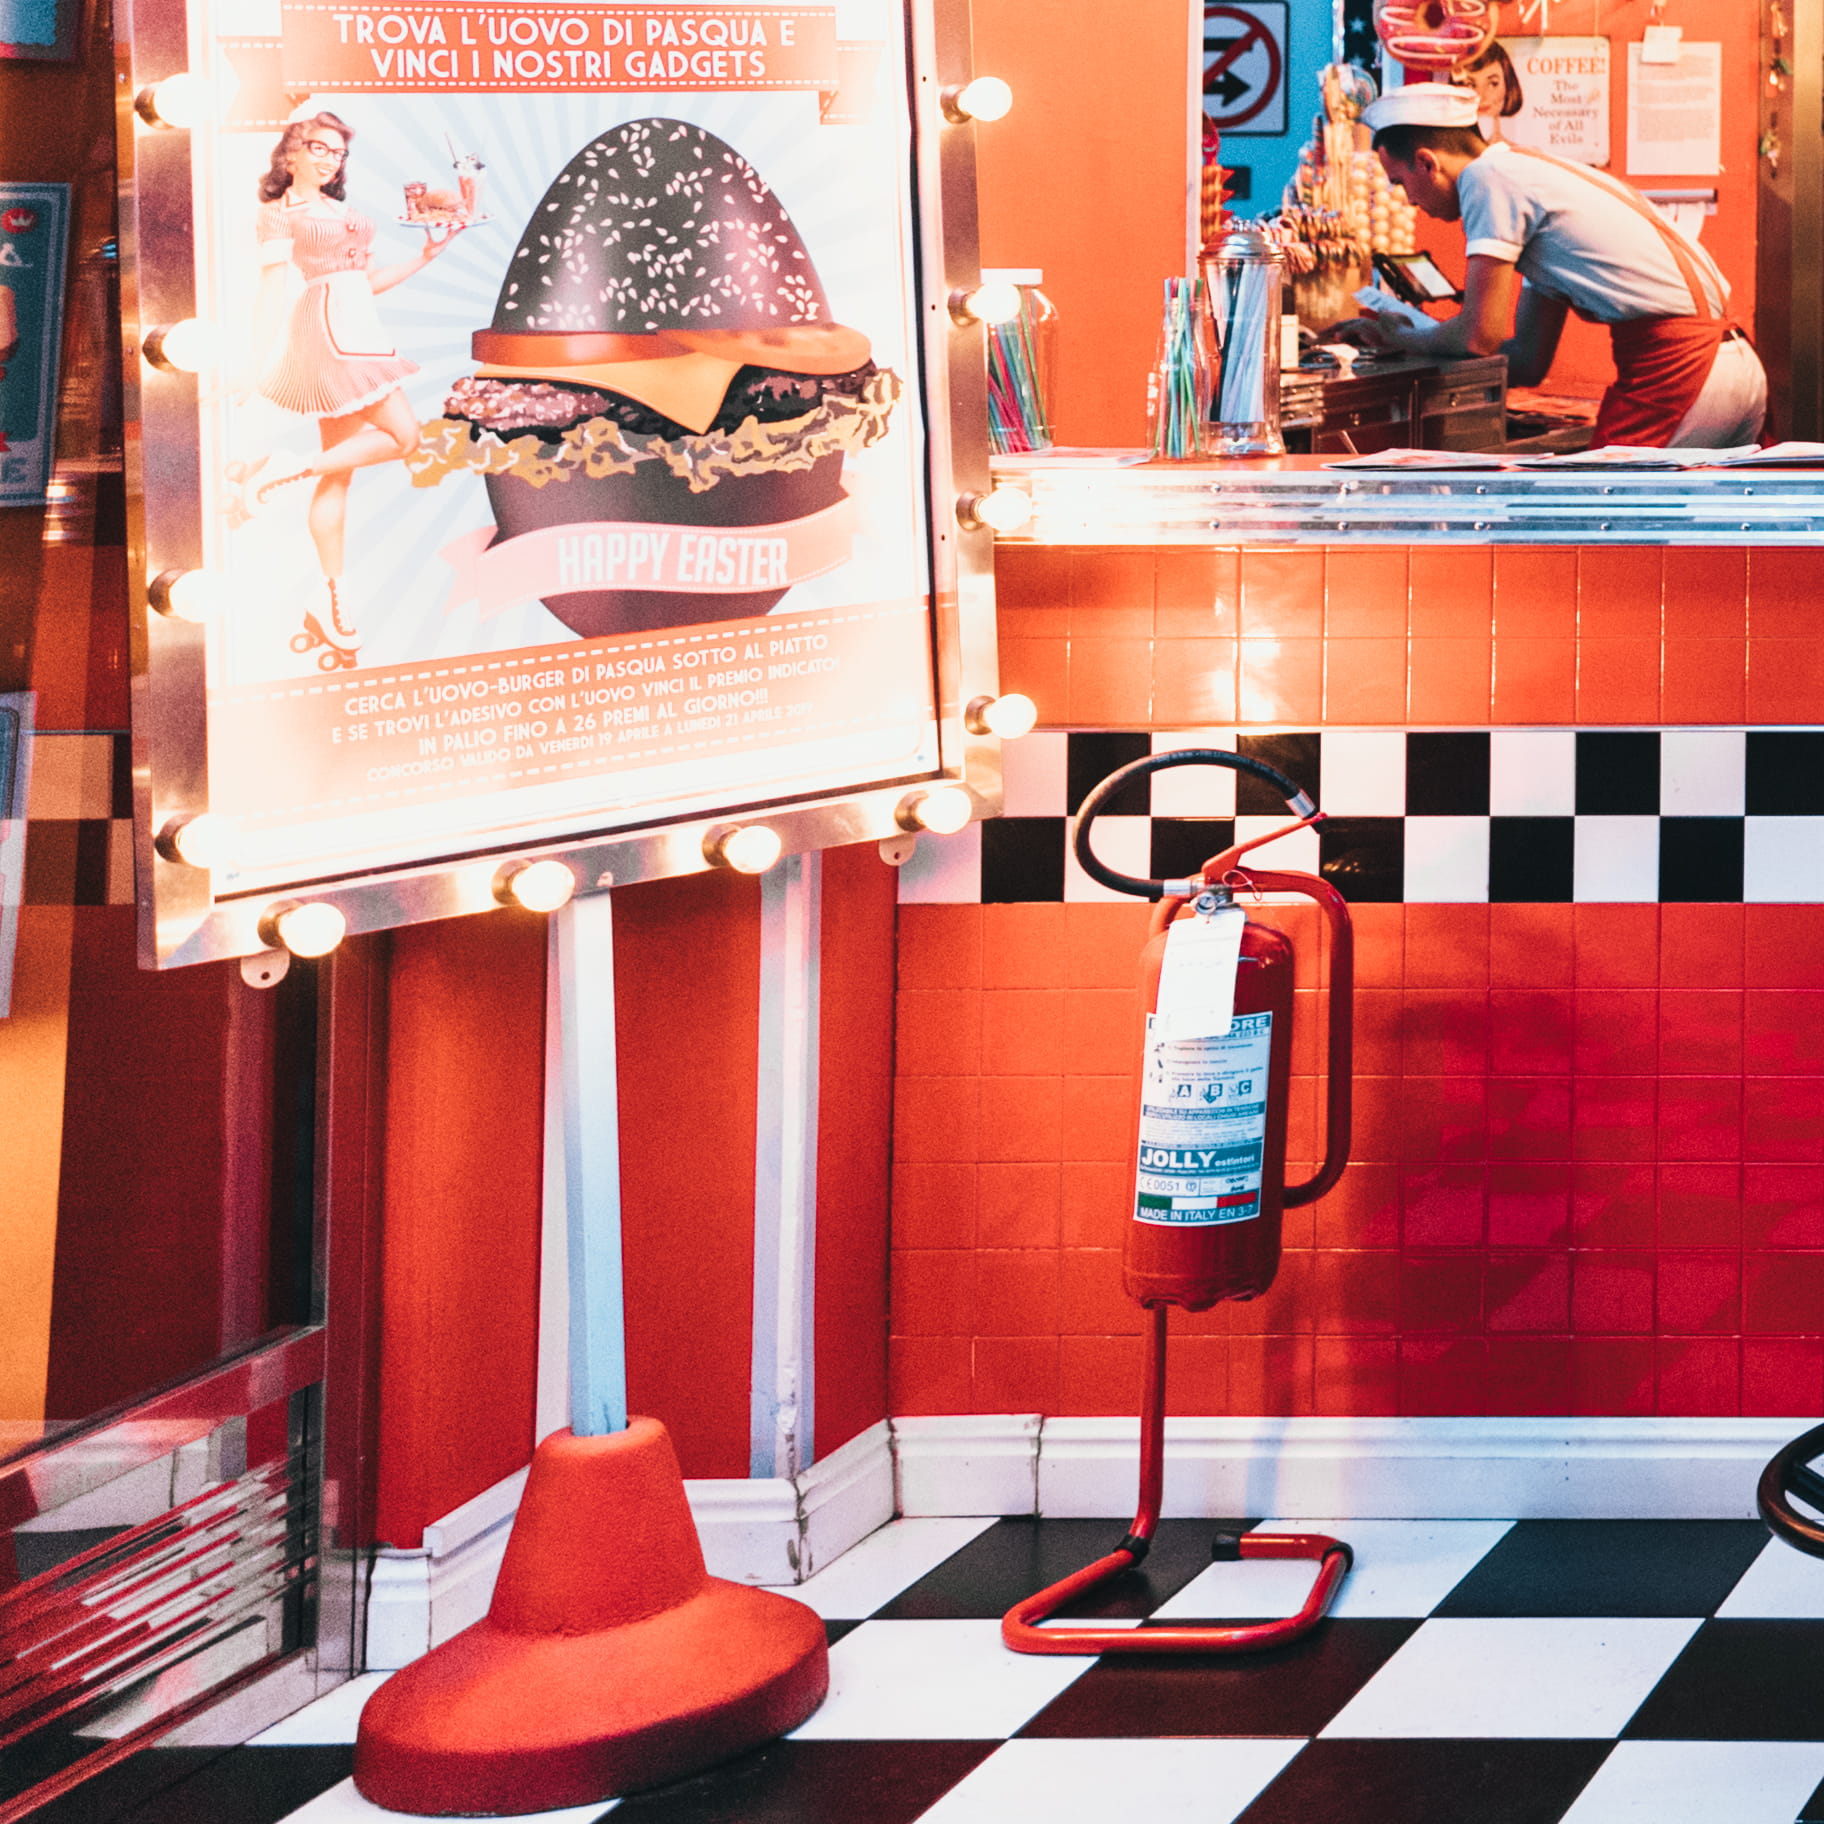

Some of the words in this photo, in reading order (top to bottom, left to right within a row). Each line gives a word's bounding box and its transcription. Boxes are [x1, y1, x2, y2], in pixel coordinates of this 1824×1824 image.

[332, 14, 446, 45] TROVA
[461, 13, 590, 47] L'UOVO
[603, 18, 634, 46] DI
[645, 18, 767, 50] PASQUA
[780, 20, 796, 47] E
[370, 49, 459, 78] VINCI
[471, 51, 480, 78] I
[493, 50, 611, 78] NOSTRI
[624, 50, 766, 78] GADGETS
[1526, 56, 1607, 75] COFFEE!
[1553, 80, 1579, 91] The
[1551, 93, 1582, 105] Most
[1533, 107, 1599, 119] Necessary
[1548, 120, 1562, 131] of
[1563, 120, 1584, 131] All
[1550, 133, 1584, 145] Evils
[558, 531, 671, 587] HAPPY
[676, 533, 789, 586] EASTER
[345, 693, 406, 716] CERCA
[413, 670, 565, 707] L'UOVO-BURGER
[572, 666, 590, 685] DI
[596, 656, 666, 681] PASQUA
[672, 646, 737, 670] SOTTO
[744, 642, 764, 661] AL
[769, 634, 828, 657] PIATTO
[332, 727, 342, 744] E
[347, 724, 369, 742] SE
[374, 715, 430, 737] TROVI
[435, 701, 522, 728] L'ADESIVO
[528, 695, 566, 714] CON
[571, 685, 636, 709] L'UOVO
[642, 678, 684, 698] VINCI
[690, 676, 703, 692] IL
[708, 667, 763, 689] PREMIO
[418, 736, 437, 755] IN
[443, 728, 497, 753] PALIO
[503, 721, 548, 743] FINO
[555, 718, 567, 734] A
[574, 713, 597, 732] 26
[603, 704, 650, 726] PREMI
[656, 701, 677, 719] AL
[684, 687, 769, 714] GIORNO!!!
[460, 747, 511, 768] VALIDO
[516, 743, 534, 759] DA
[539, 733, 594, 755] VENERDI
[598, 732, 612, 747] 19
[617, 724, 659, 744] APRILE
[663, 722, 673, 736] A
[677, 715, 721, 734] LUNEDI
[742, 704, 782, 723] APRILE
[1210, 1084, 1221, 1097] B
[1240, 1081, 1250, 1094] C
[1141, 1149, 1217, 1169] JOLLY
[1215, 1154, 1255, 1167] estintori
[1153, 1178, 1180, 1191] 0051
[1139, 1207, 1168, 1220] MADE
[1170, 1210, 1182, 1221] IN
[1184, 1209, 1217, 1221] ITALY
[1218, 1207, 1236, 1219] EN
